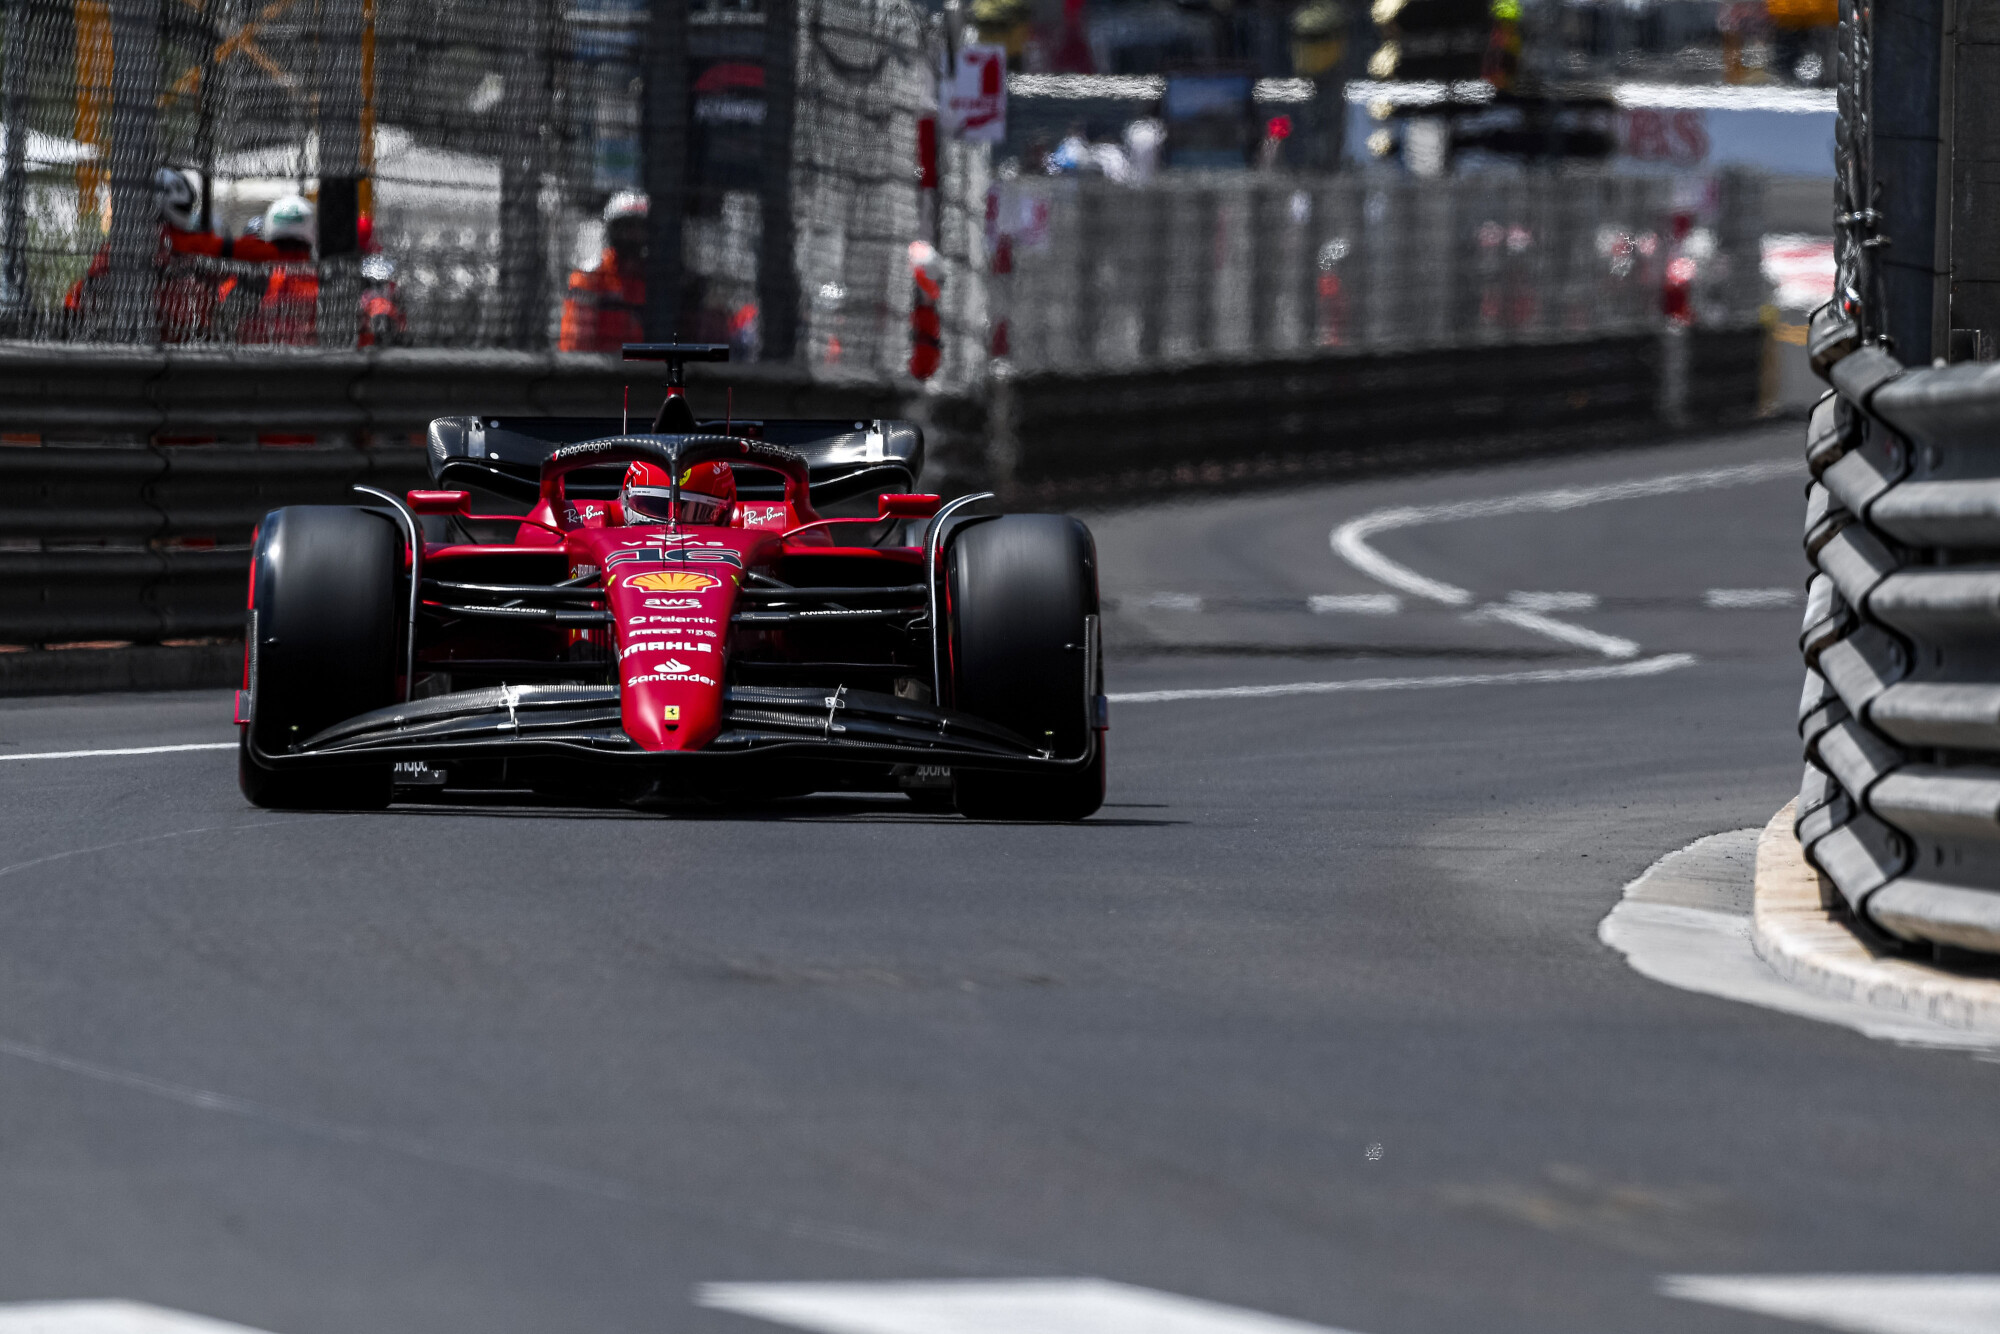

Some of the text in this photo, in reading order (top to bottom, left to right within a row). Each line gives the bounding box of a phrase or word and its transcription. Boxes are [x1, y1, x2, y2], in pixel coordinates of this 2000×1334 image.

[560, 442, 612, 457] Snapdragon
[563, 505, 604, 523] Ray-Ban
[742, 507, 784, 525] Ray-Ban
[605, 547, 743, 572] 16
[644, 598, 701, 606] aws
[649, 615, 717, 624] Palantir
[623, 641, 712, 658] MAHLE
[628, 673, 716, 687] Santander
